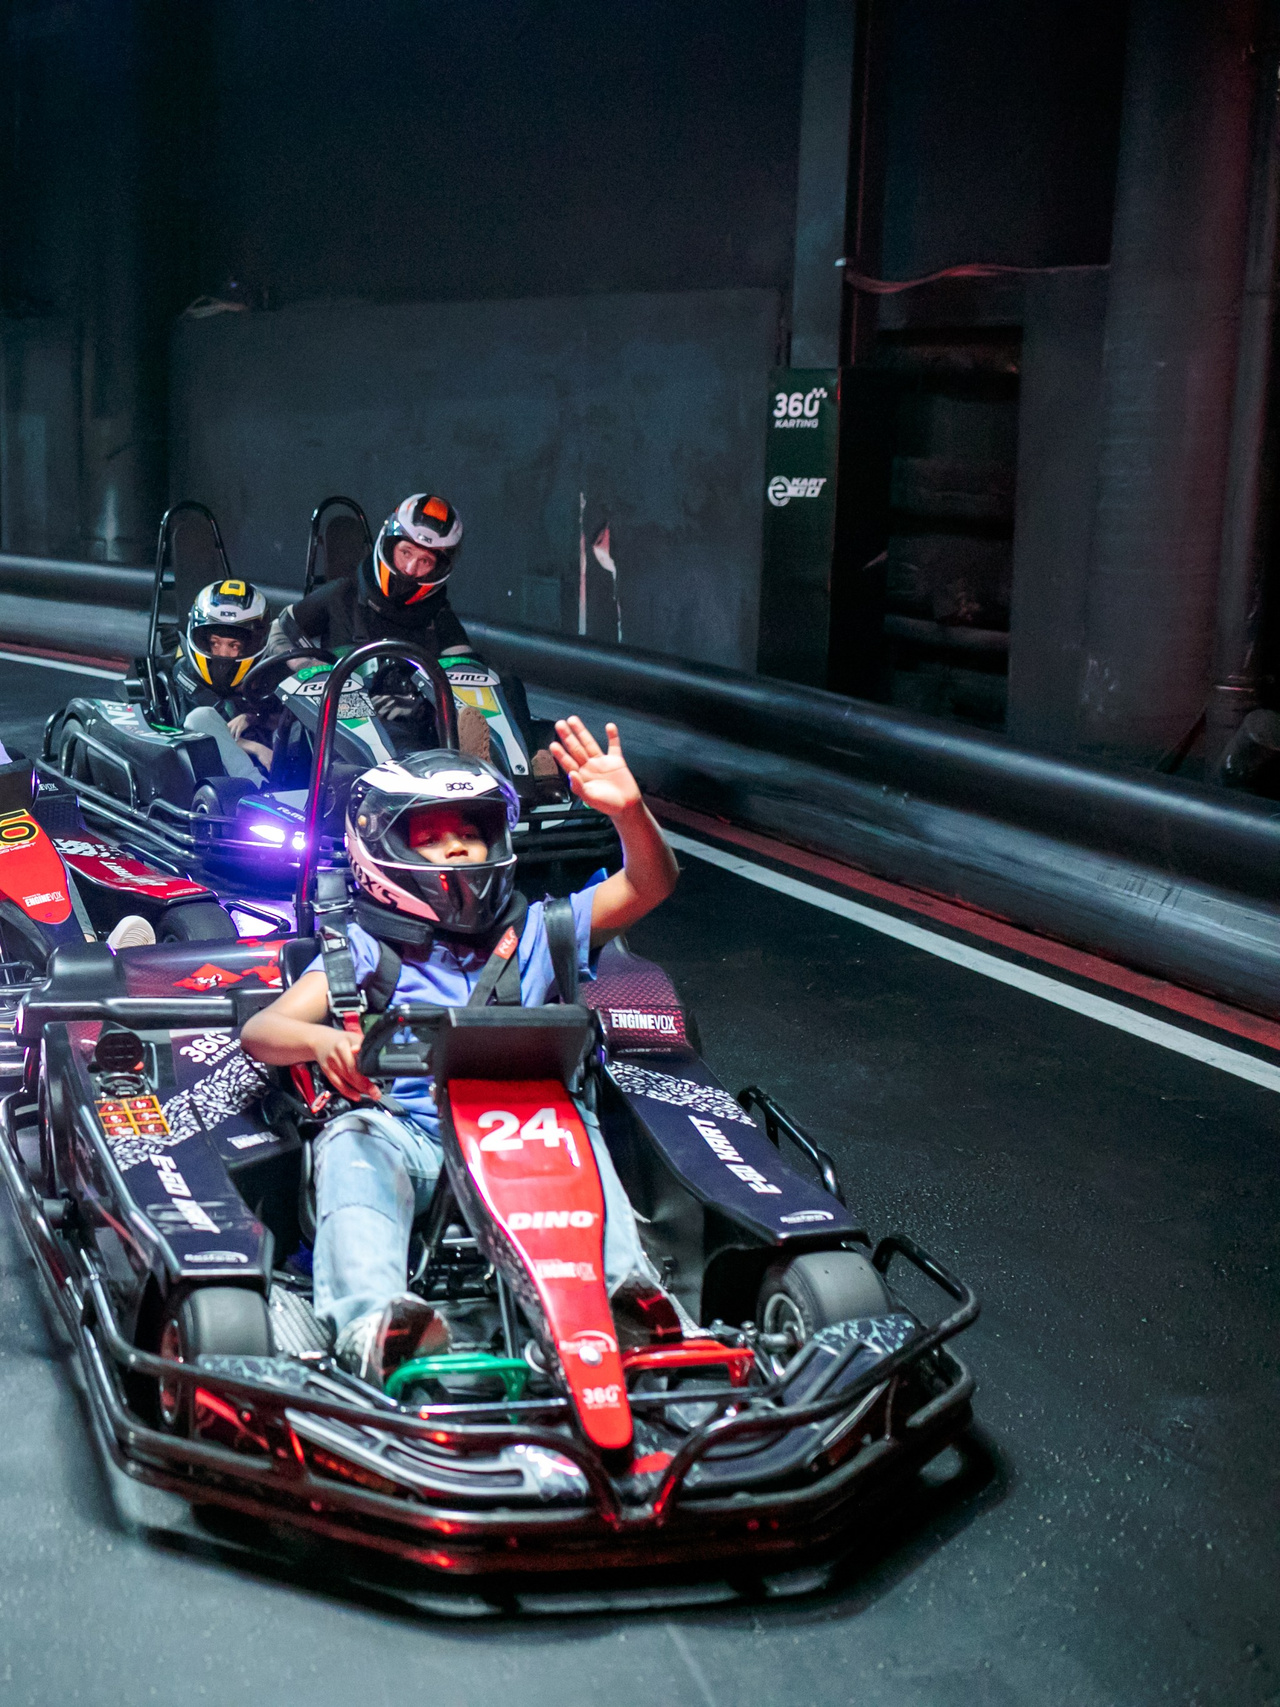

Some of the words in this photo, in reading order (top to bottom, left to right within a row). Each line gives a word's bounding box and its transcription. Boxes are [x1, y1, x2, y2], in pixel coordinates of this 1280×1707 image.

[773, 391, 821, 418] 360
[774, 419, 819, 429] KARTING
[445, 782, 474, 792] BOXS
[611, 1013, 675, 1030] ENGINEVOX
[180, 1031, 231, 1063] 360
[204, 1038, 242, 1067] KARTING
[478, 1107, 565, 1152] 24
[688, 1115, 745, 1163] KART
[507, 1210, 595, 1230] DINO
